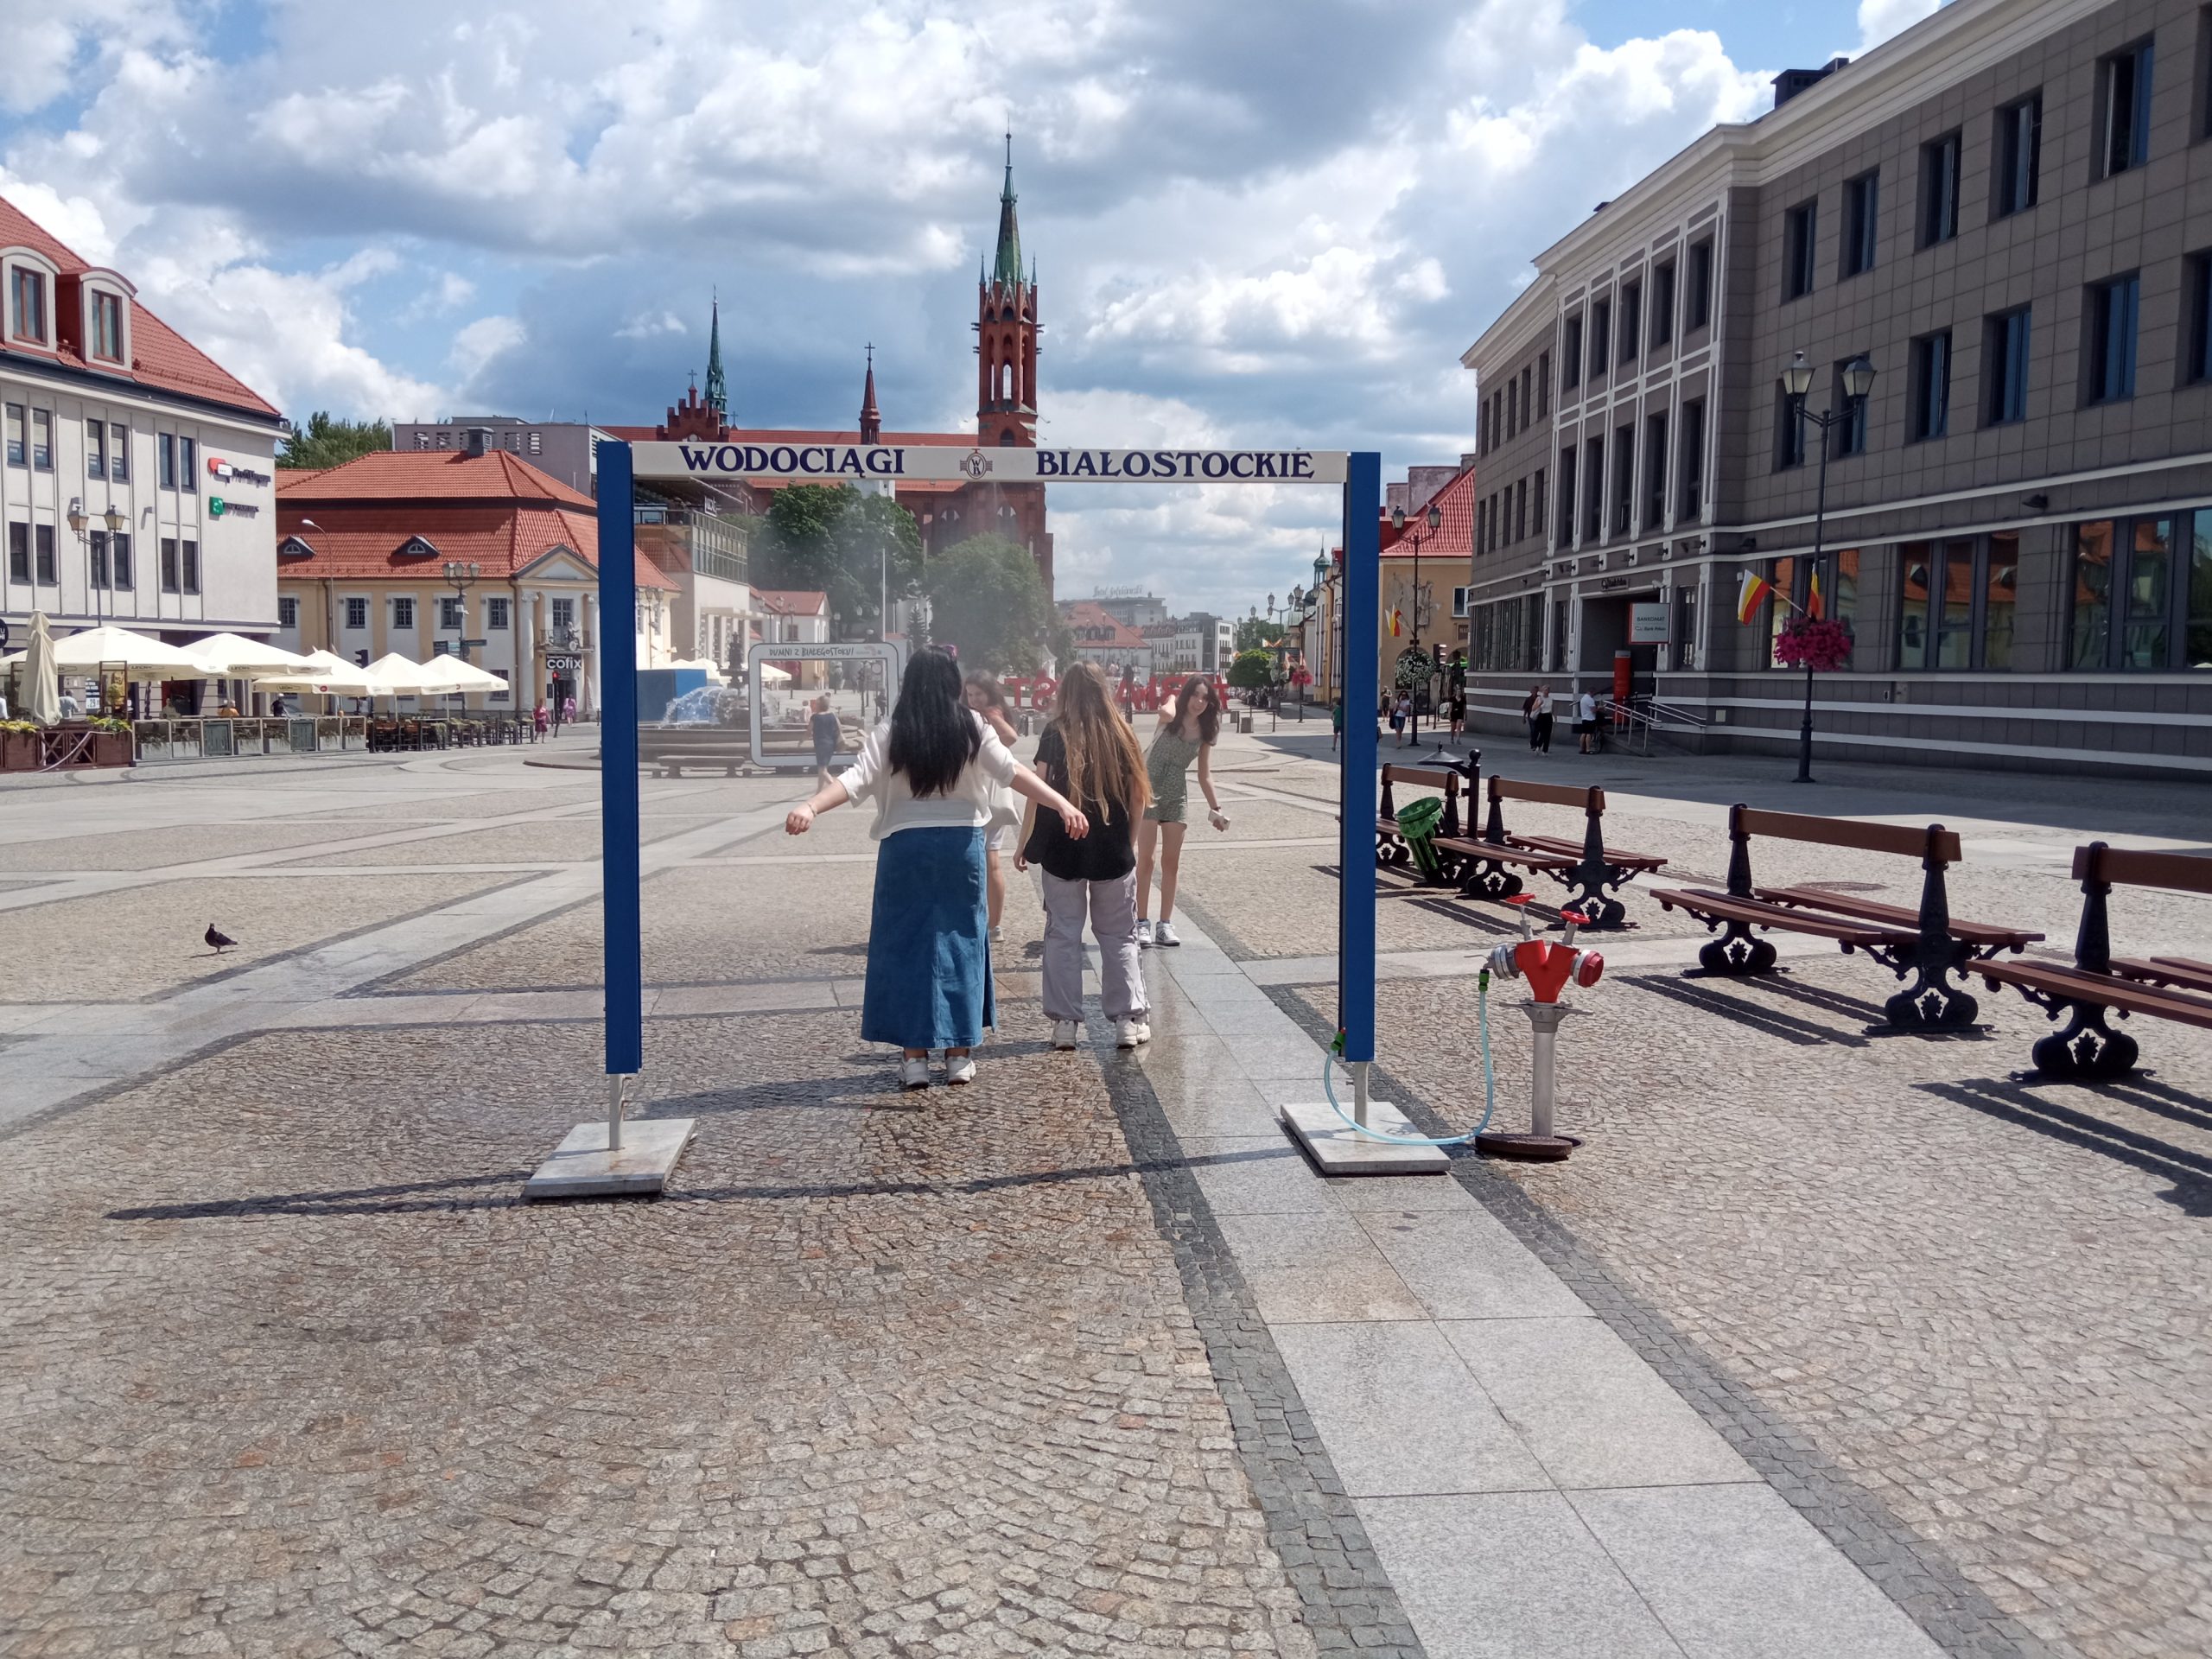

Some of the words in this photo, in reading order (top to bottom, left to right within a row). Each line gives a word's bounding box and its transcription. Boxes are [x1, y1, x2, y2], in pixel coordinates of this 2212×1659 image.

[678, 445, 905, 478] WODOCIĄGI
[1036, 451, 1314, 479] BIAŁOSTOCKIE
[547, 657, 582, 669] cofix
